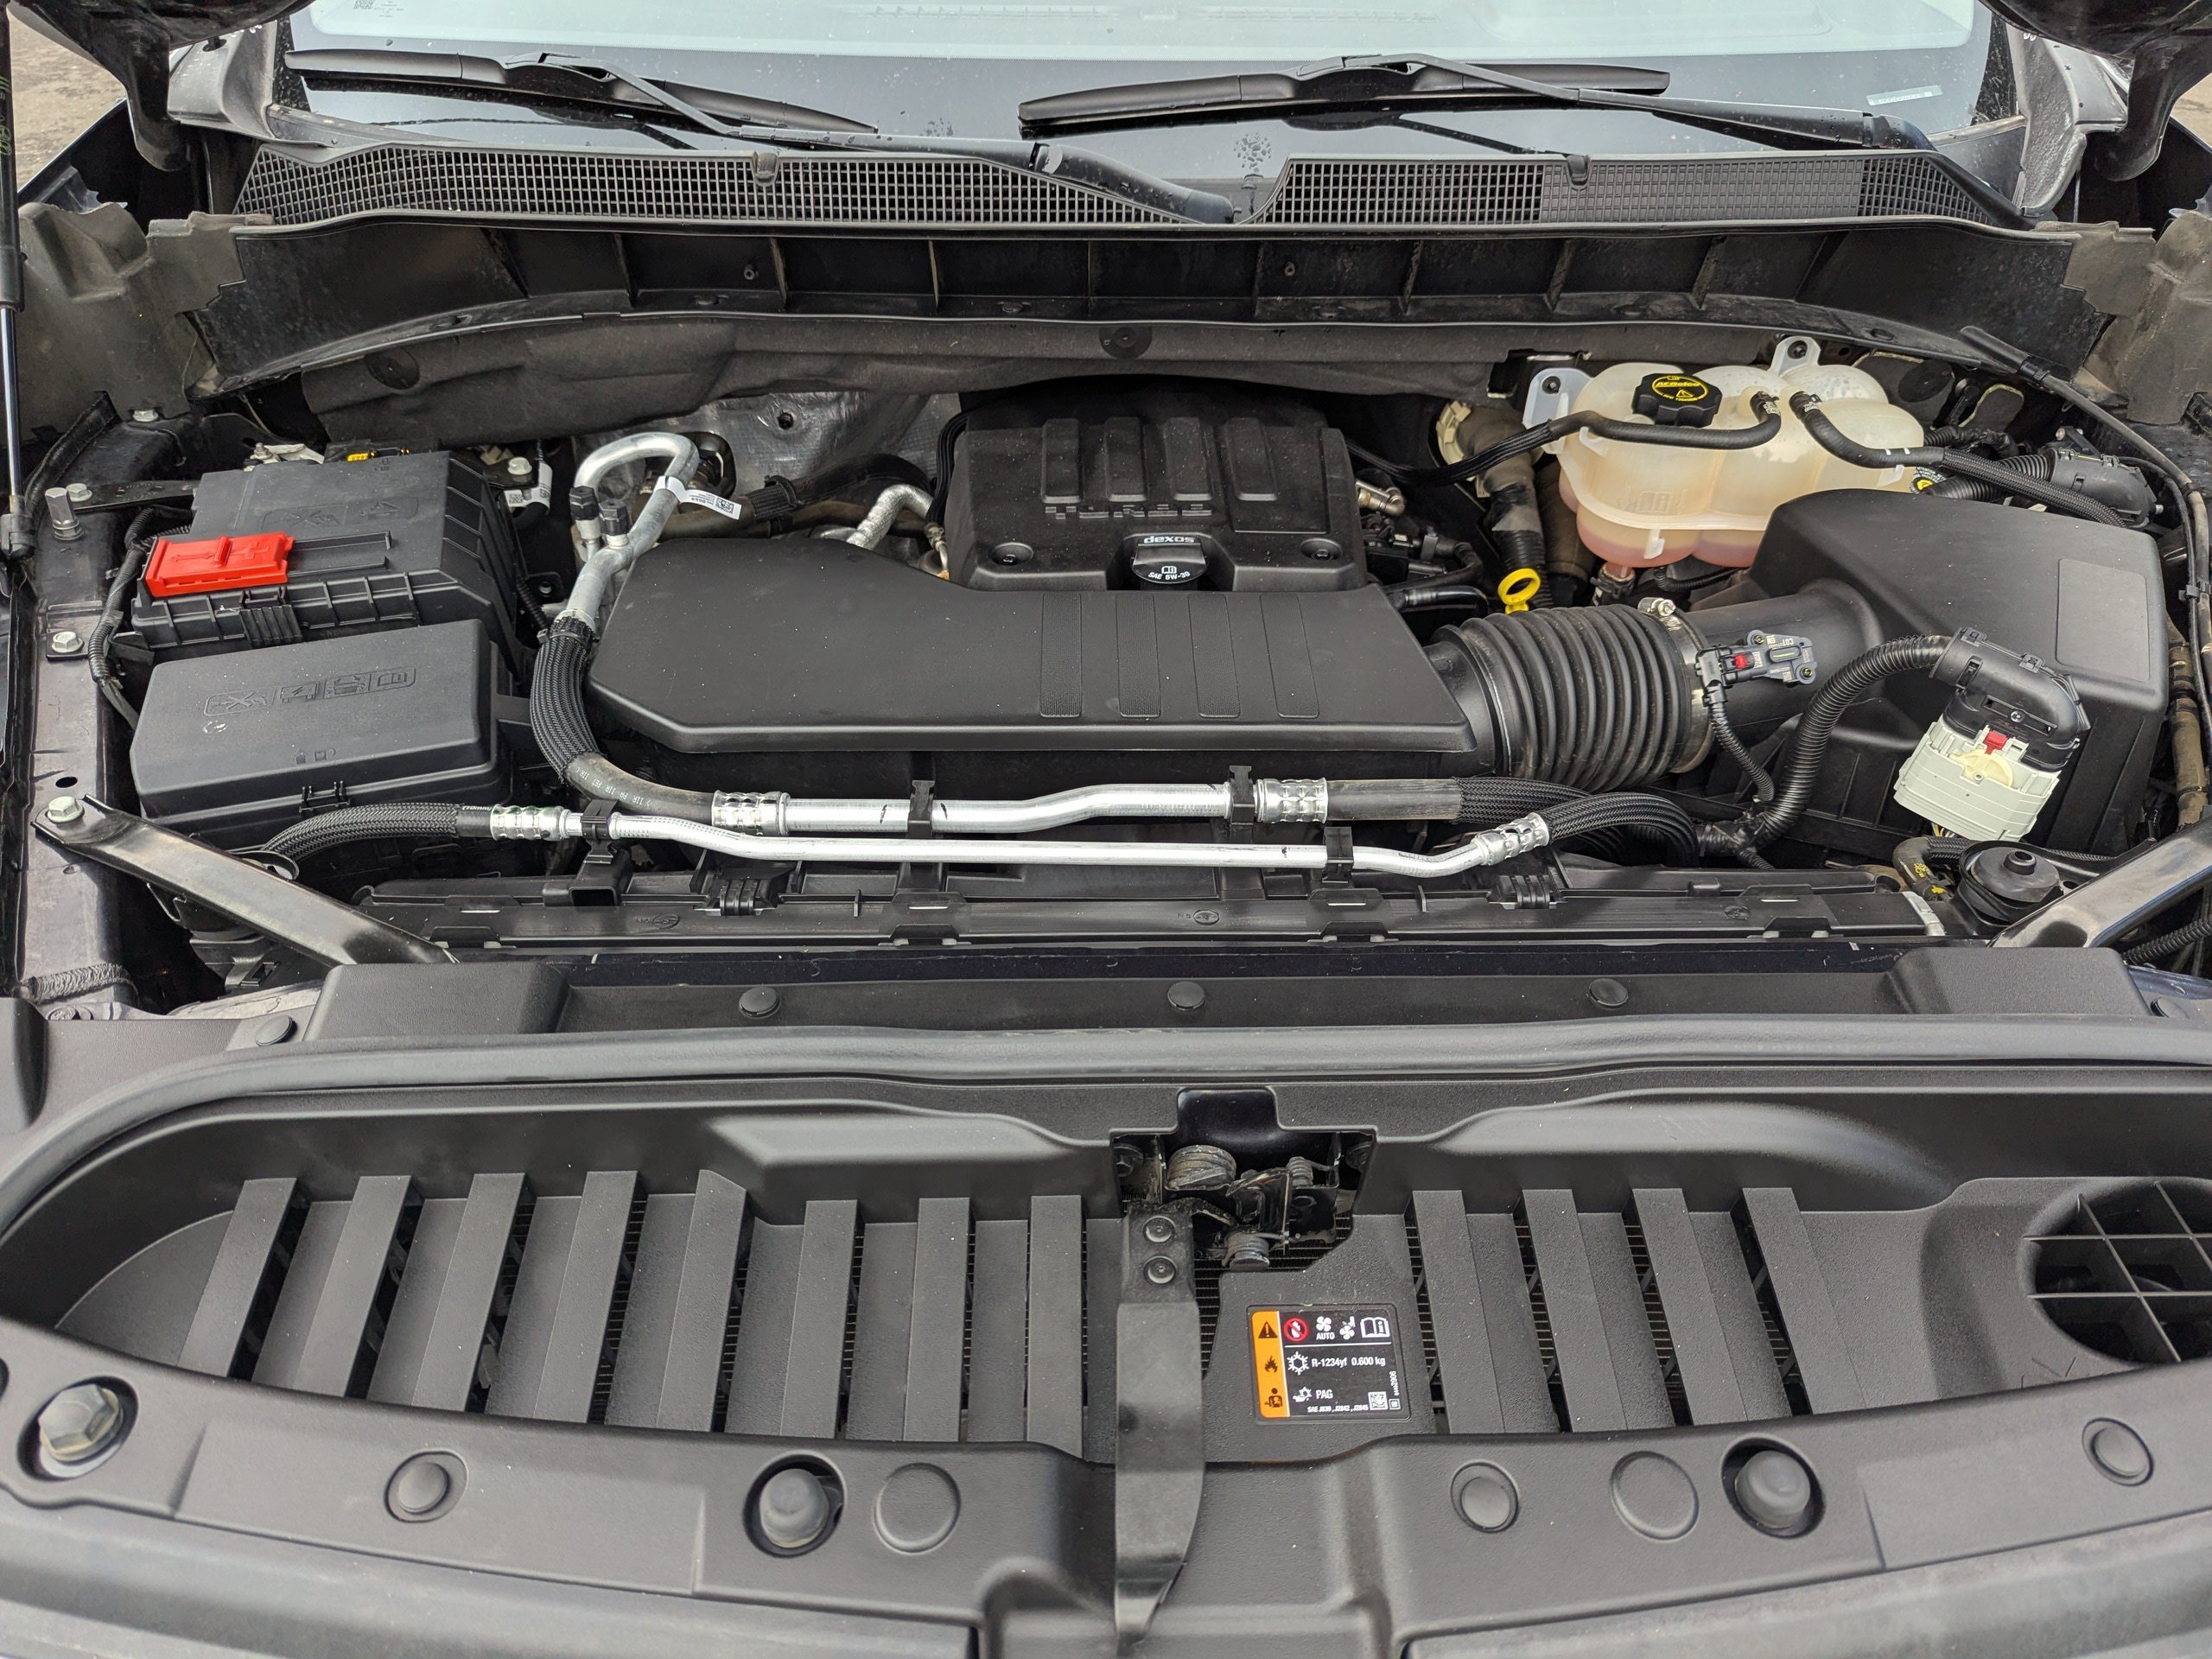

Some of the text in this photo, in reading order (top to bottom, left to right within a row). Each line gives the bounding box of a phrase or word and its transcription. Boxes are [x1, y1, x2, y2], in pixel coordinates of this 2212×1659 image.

[1311, 1357, 1386, 1368] R-1234yf 0.600 kg
[1316, 1389, 1333, 1399] PAG
